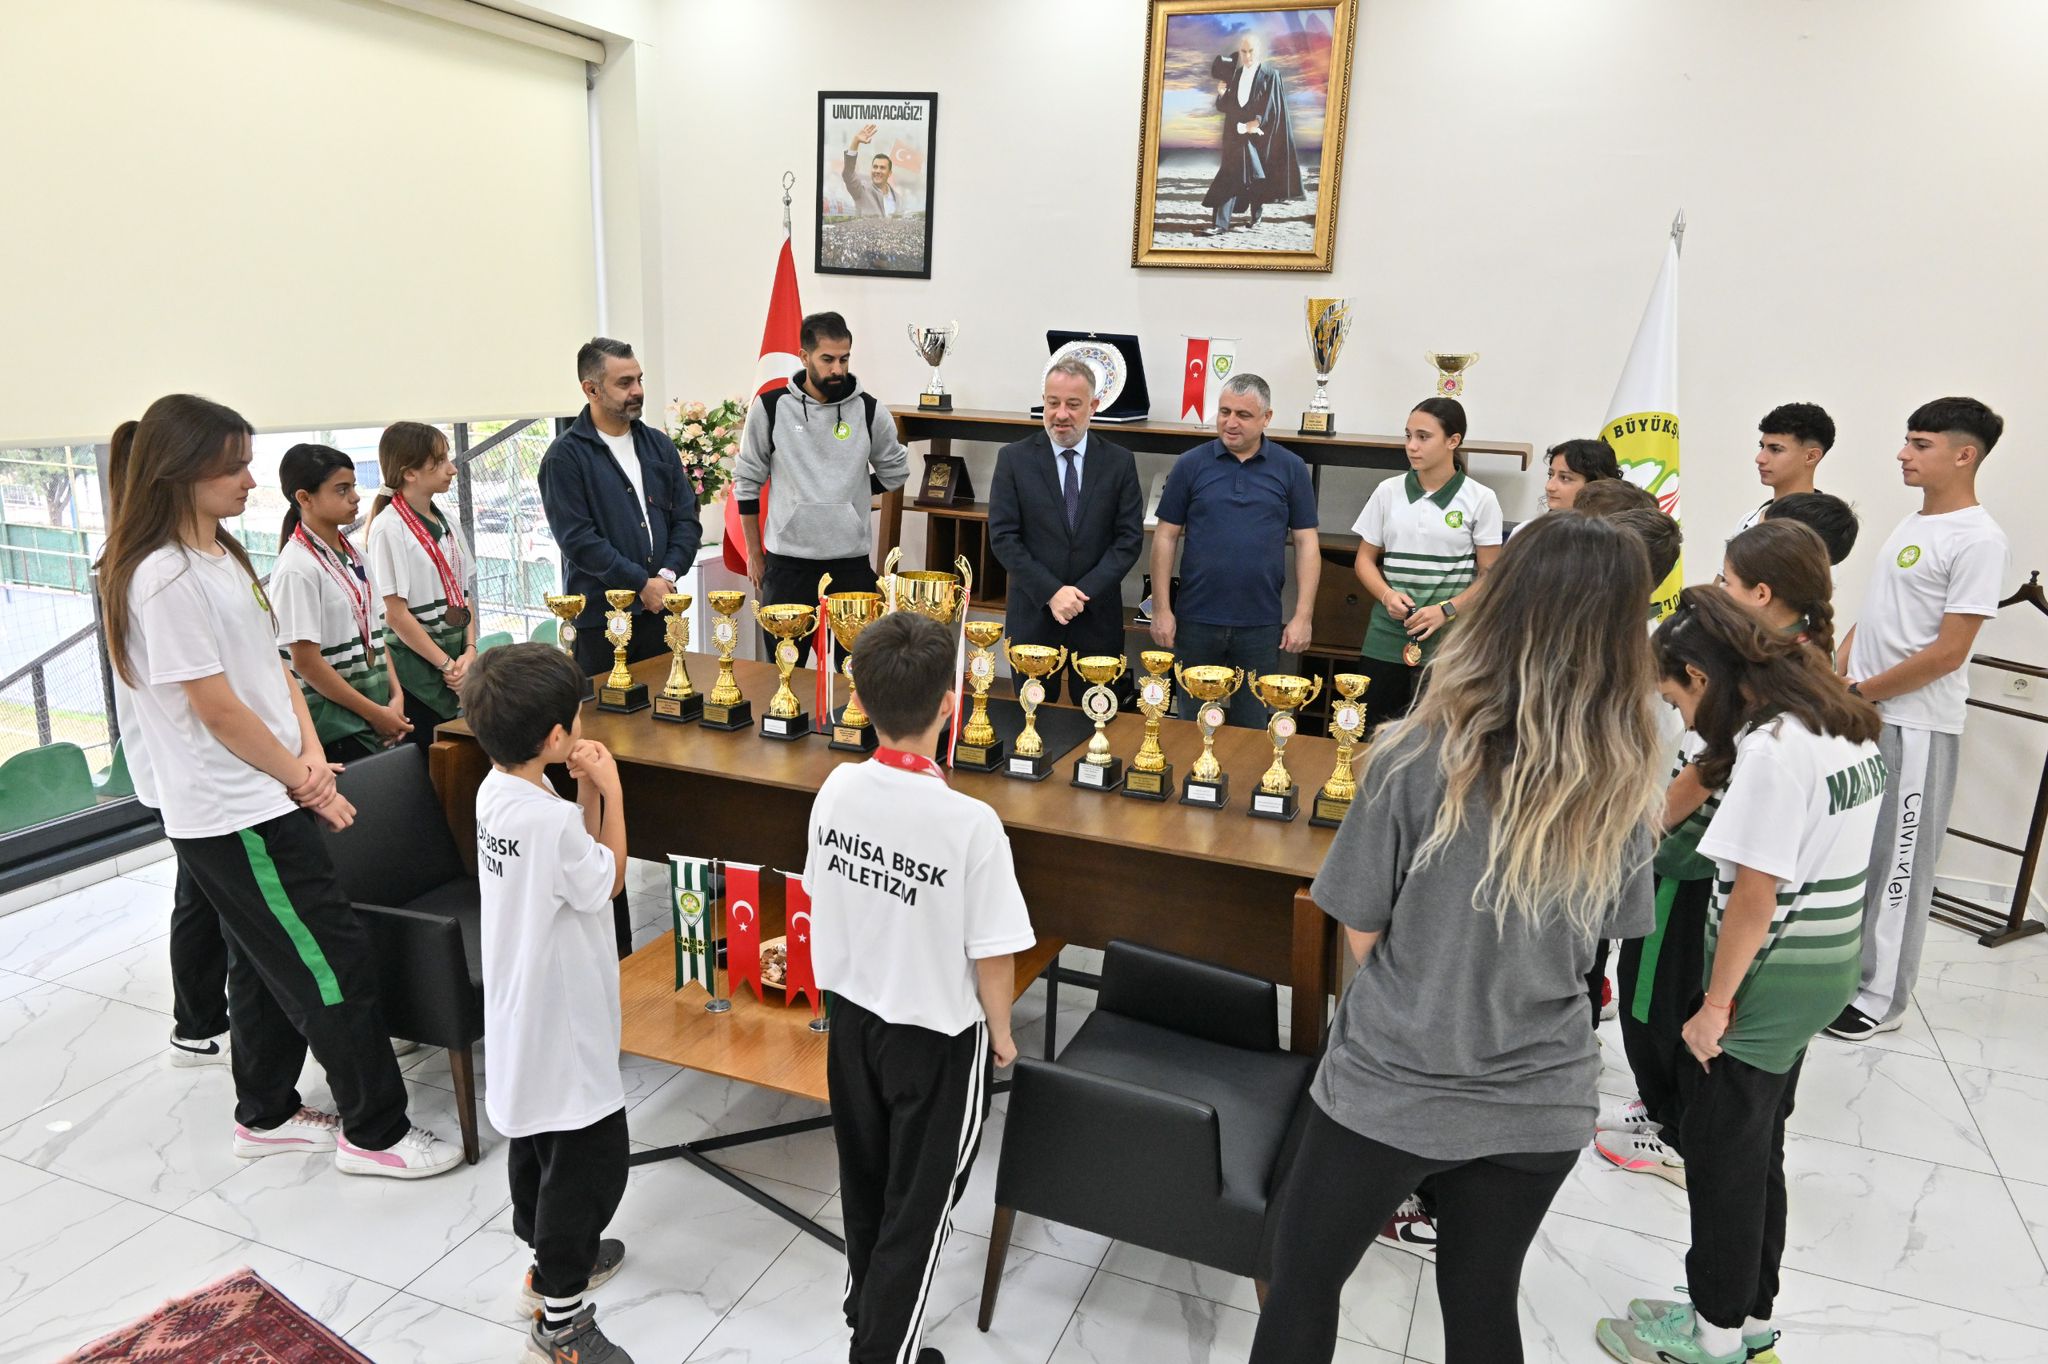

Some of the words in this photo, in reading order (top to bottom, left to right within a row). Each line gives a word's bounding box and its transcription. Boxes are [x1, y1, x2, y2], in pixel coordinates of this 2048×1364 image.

[832, 102, 923, 121] UNUTMAYACAĞIZ!
[827, 854, 917, 906] ATLETİZM
[892, 851, 949, 887] BBSK
